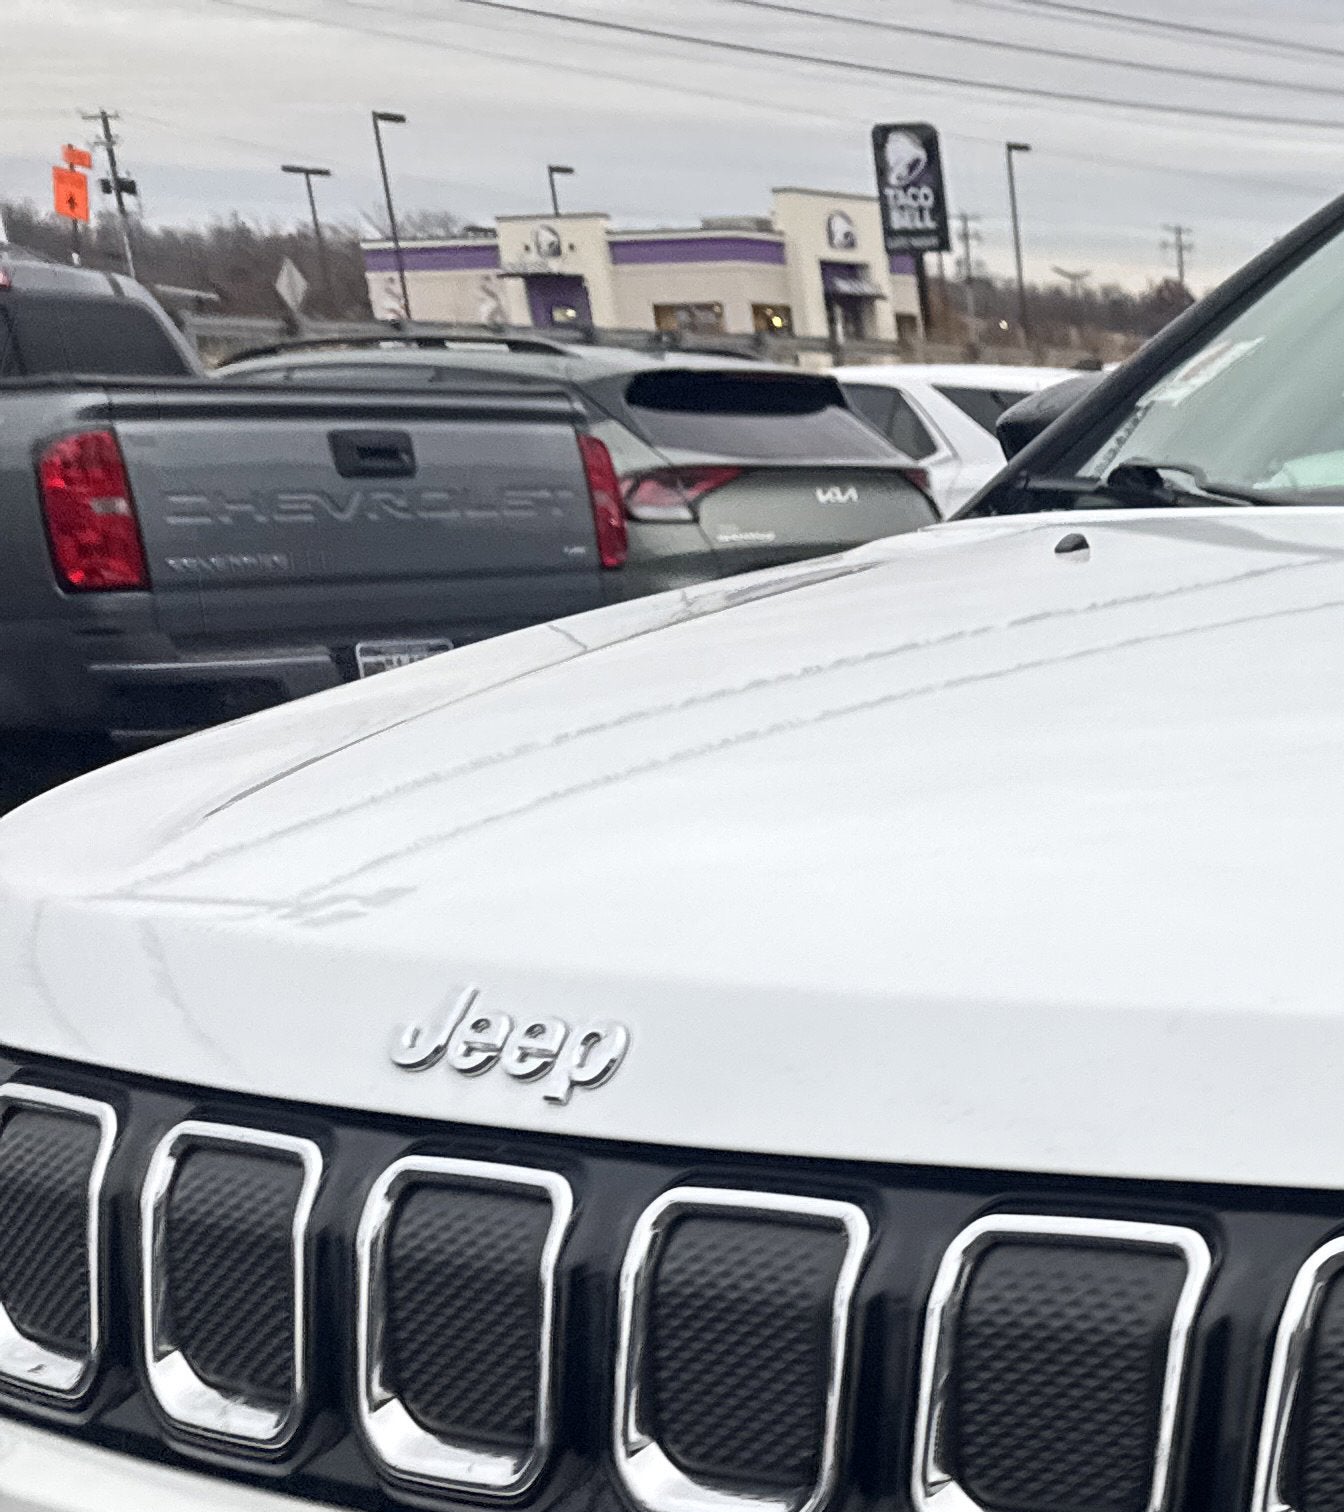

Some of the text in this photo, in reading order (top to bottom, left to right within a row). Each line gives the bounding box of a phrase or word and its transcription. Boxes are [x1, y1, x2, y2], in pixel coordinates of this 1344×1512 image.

[884, 186, 934, 208] TACO
[163, 488, 576, 526] CHEVROLET
[815, 485, 859, 504] KIA
[389, 983, 630, 1106] Jeep
